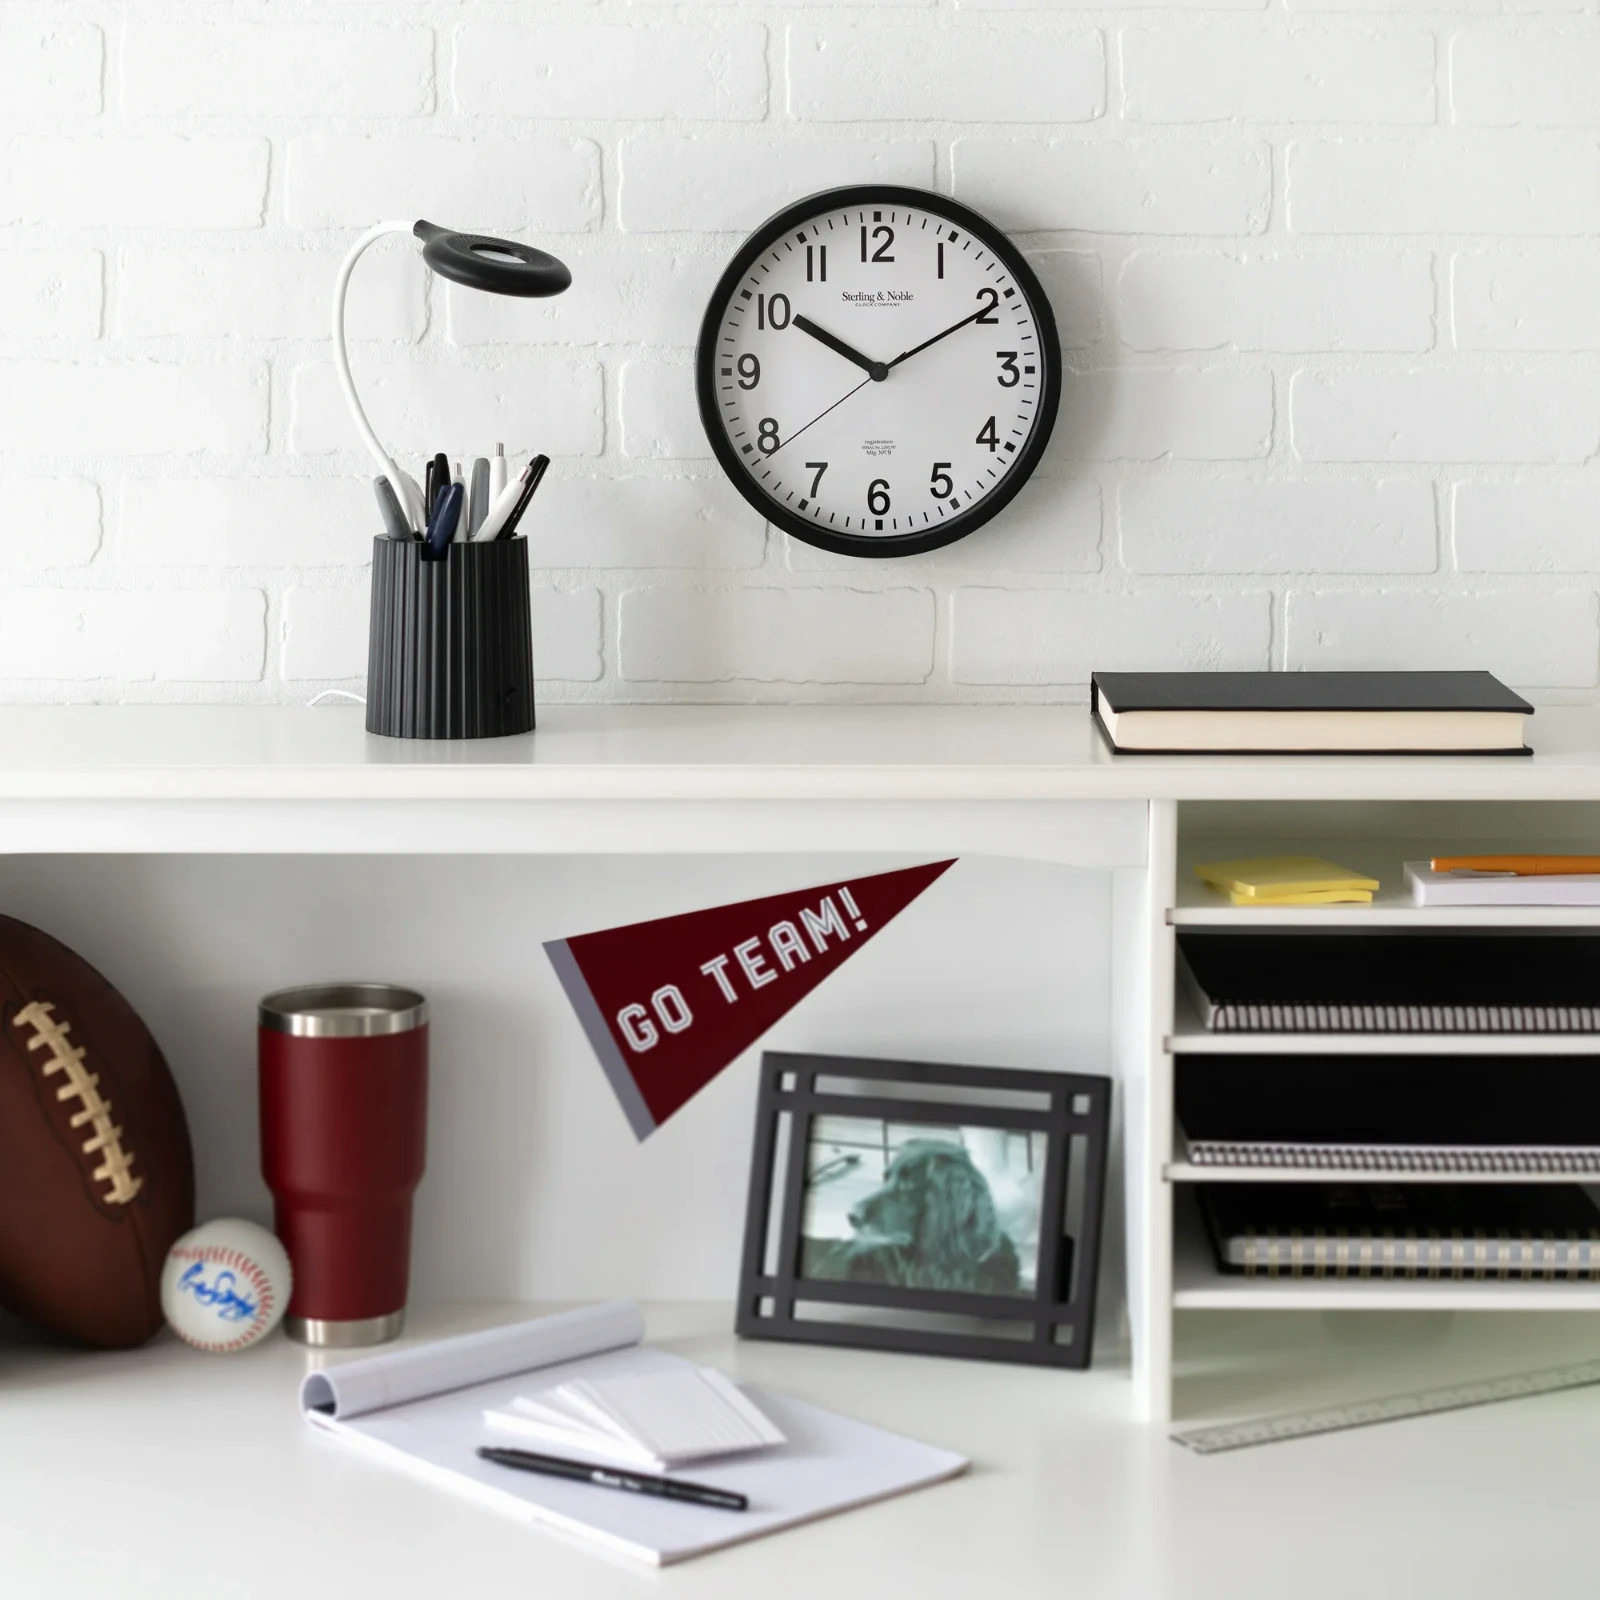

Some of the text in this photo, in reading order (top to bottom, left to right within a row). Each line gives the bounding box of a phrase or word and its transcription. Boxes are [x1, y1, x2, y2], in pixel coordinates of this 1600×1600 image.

[860, 225, 895, 263] 12
[937, 242, 944, 280] 1
[806, 244, 827, 282] 11
[757, 293, 791, 330] 10
[841, 290, 914, 304] Sterling & Noble
[975, 287, 1000, 324] 2
[737, 353, 761, 390] 9
[996, 351, 1021, 388] 3
[756, 417, 782, 454] 8
[975, 415, 1000, 453] 4
[805, 462, 829, 499] 7
[867, 479, 891, 516] 6
[929, 463, 954, 500] 5
[616, 886, 868, 1053] GO TEAM!
